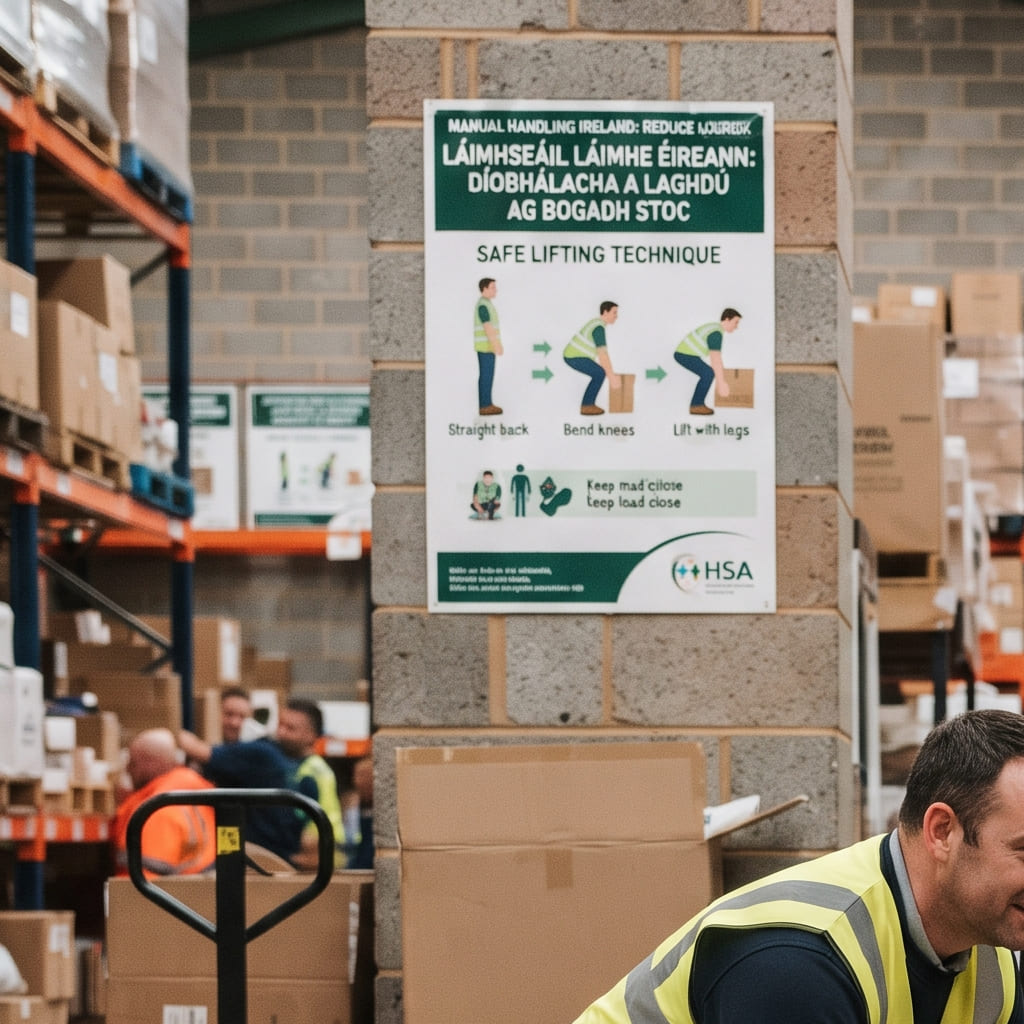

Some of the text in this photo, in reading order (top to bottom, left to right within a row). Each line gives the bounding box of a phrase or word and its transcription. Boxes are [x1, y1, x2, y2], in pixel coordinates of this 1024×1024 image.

[448, 119, 504, 133] MANUAL
[507, 119, 576, 134] HANDLING
[579, 119, 640, 134] IRELAND:
[643, 120, 695, 135] REDUCE
[443, 138, 757, 168] LÁIMHSEÁIL LÁIMHE ÉIREANN:
[468, 166, 730, 195] DÍOBHÁLACHA A LAGHDÚ
[507, 200, 691, 222] AG BOGADH STOC
[477, 245, 721, 265] SAFE LIFTING TECHNIQUE
[448, 423, 529, 440] Straight back
[563, 423, 635, 436] Bend knees
[723, 423, 750, 440] legs
[705, 561, 753, 580] HSA
